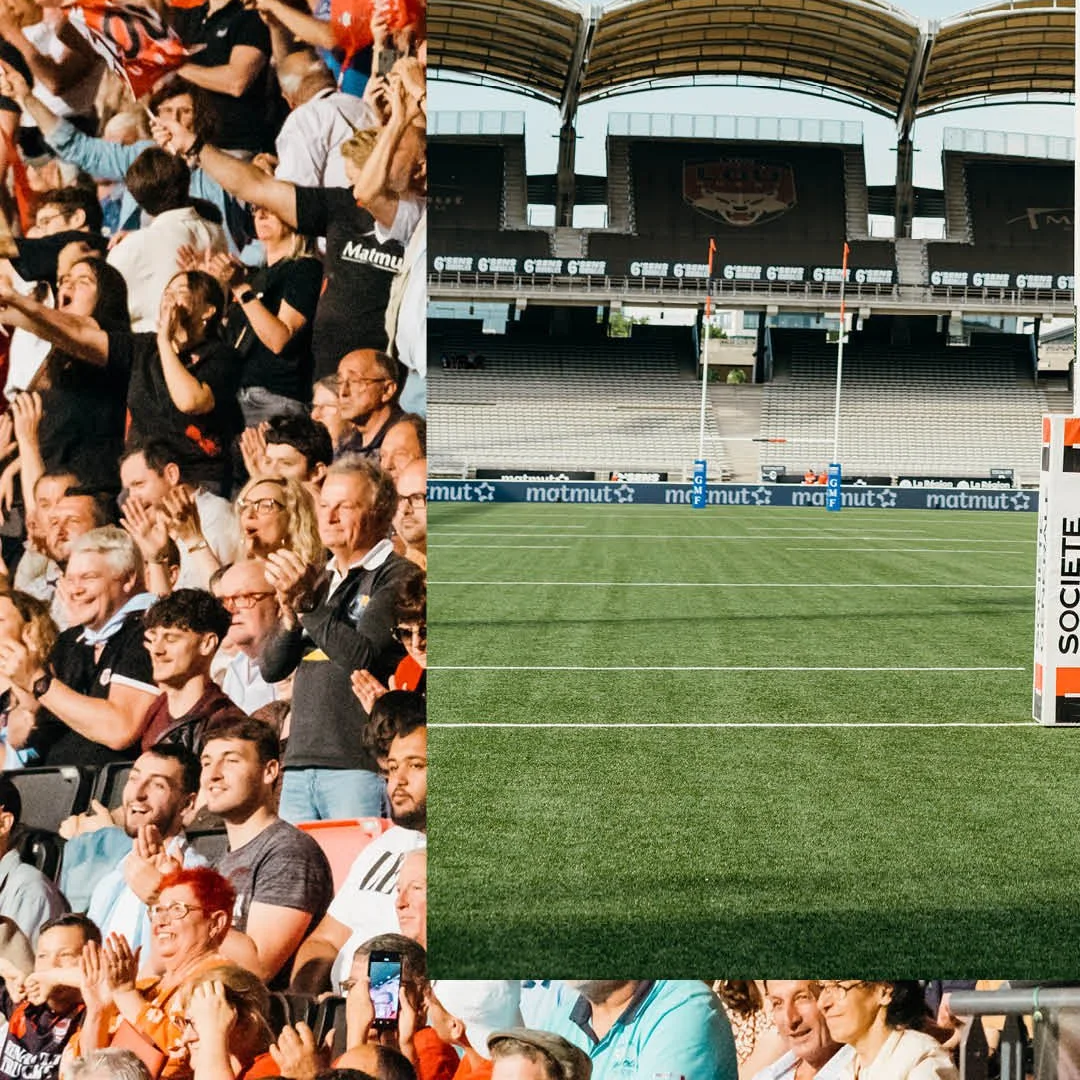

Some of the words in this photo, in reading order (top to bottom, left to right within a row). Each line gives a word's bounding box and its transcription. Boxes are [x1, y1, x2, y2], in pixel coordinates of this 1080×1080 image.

[342, 240, 404, 270] Matmu
[526, 485, 612, 503] matmut
[792, 490, 876, 508] mamut
[828, 478, 838, 508] GMF
[926, 492, 1010, 509] matmut
